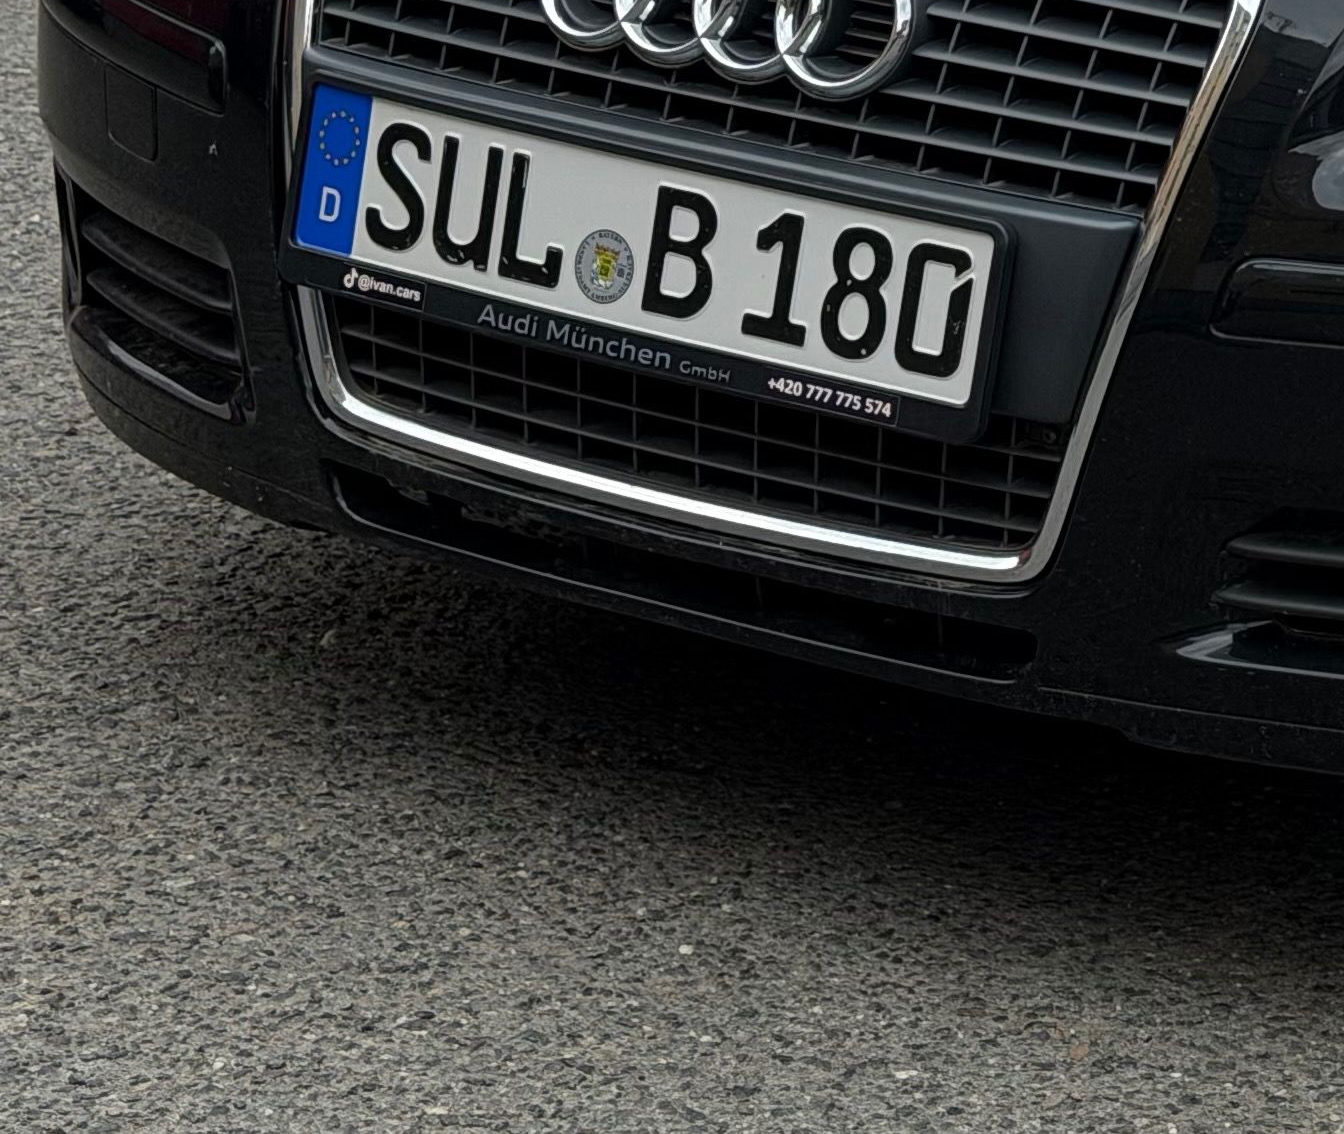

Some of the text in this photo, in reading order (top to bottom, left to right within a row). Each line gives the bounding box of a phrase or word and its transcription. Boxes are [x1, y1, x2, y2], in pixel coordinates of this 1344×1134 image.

[318, 187, 340, 223] D
[365, 122, 977, 378] SUL B 180
[358, 275, 421, 302] @ivan.cars
[477, 304, 731, 383] Audi München GmbH
[768, 378, 892, 417] +420 777 775 574
